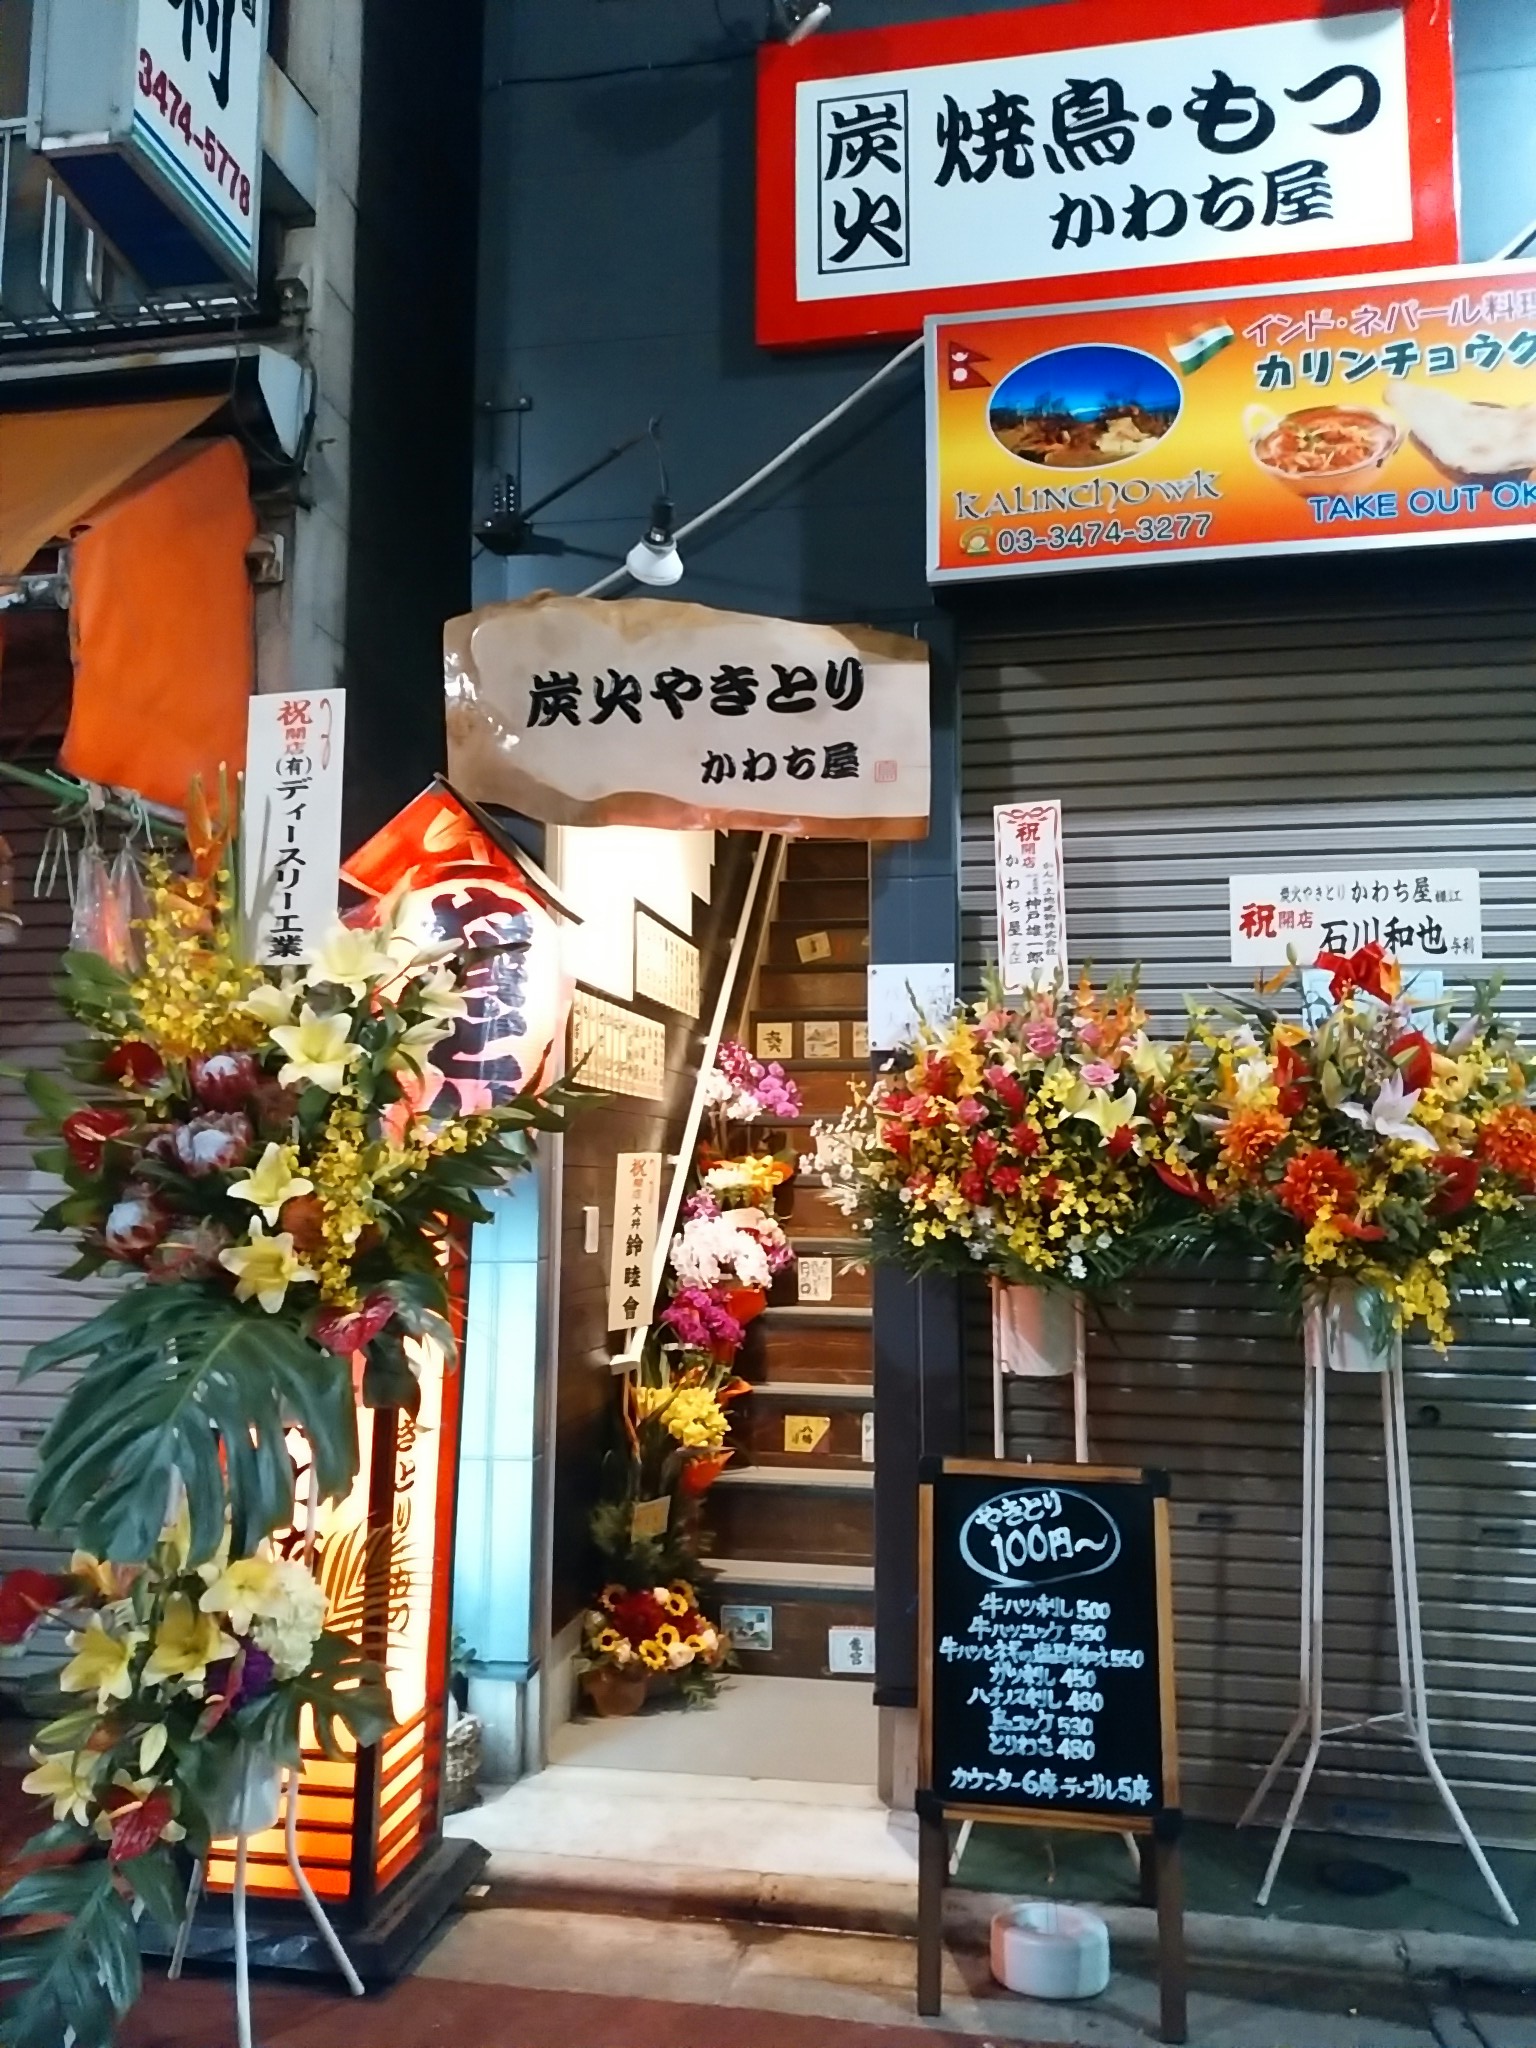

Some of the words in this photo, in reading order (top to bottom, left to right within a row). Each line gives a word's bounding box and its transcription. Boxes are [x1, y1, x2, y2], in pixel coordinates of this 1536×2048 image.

[138, 48, 250, 216] 3474-5778
[934, 64, 1381, 186] 焼鳥・もつ
[824, 102, 904, 263] 炭火
[1050, 160, 1334, 250] かわち屋
[1309, 493, 1397, 522] TAKE
[1409, 486, 1481, 515] OUT
[1494, 482, 1536, 508] OK
[998, 512, 1213, 554] 03-3474-3277
[525, 656, 866, 728] 炭火やきとり
[700, 741, 861, 786] かわち屋
[975, 1490, 1062, 1531] やきとり
[967, 1614, 1065, 1641] 牛ハツユッケ
[1070, 1624, 1107, 1642] 550
[1076, 1599, 1111, 1620] 500
[1060, 1668, 1097, 1688] 450
[1110, 1649, 1145, 1669] 550
[1065, 1690, 1104, 1713] 480
[1057, 1716, 1094, 1736] 530
[1056, 1737, 1095, 1760] 480
